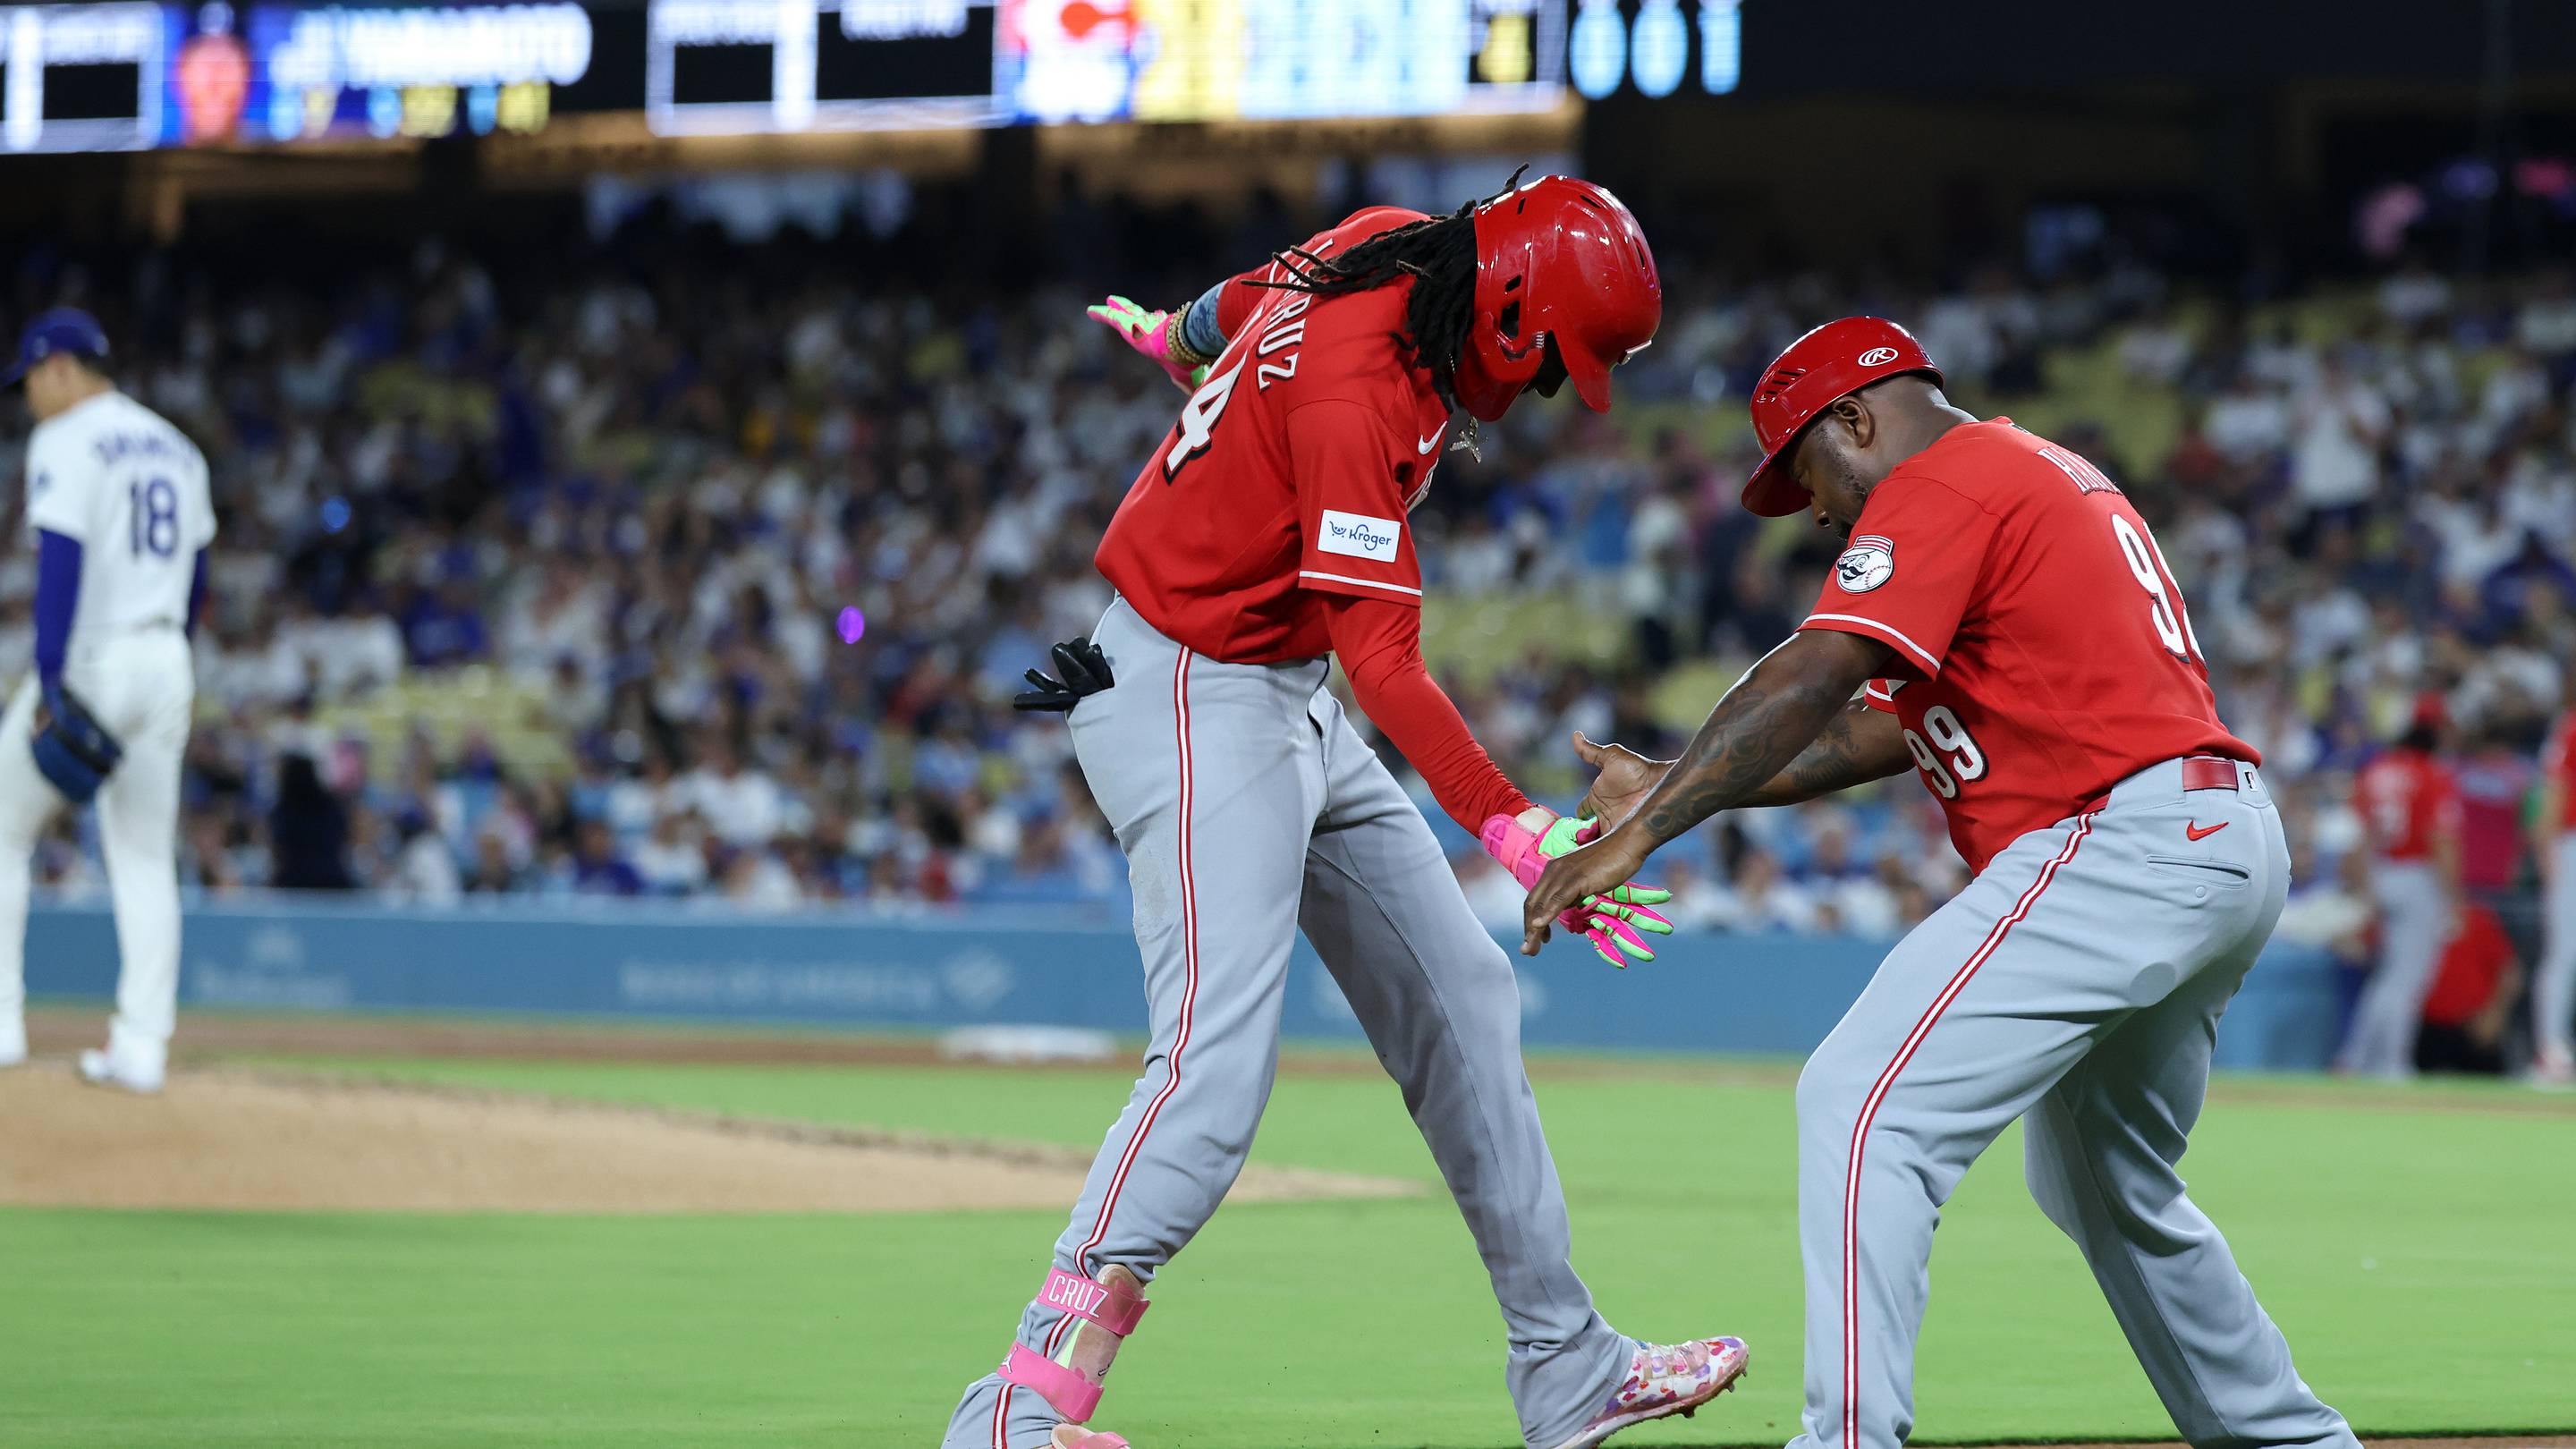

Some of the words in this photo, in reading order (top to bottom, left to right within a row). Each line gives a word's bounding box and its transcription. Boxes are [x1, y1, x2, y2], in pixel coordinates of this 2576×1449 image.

[129, 477, 177, 559] 18
[1349, 524, 1392, 551] Kroger
[1902, 704, 1987, 800] 99
[1048, 1275, 1109, 1318] CRUZ
